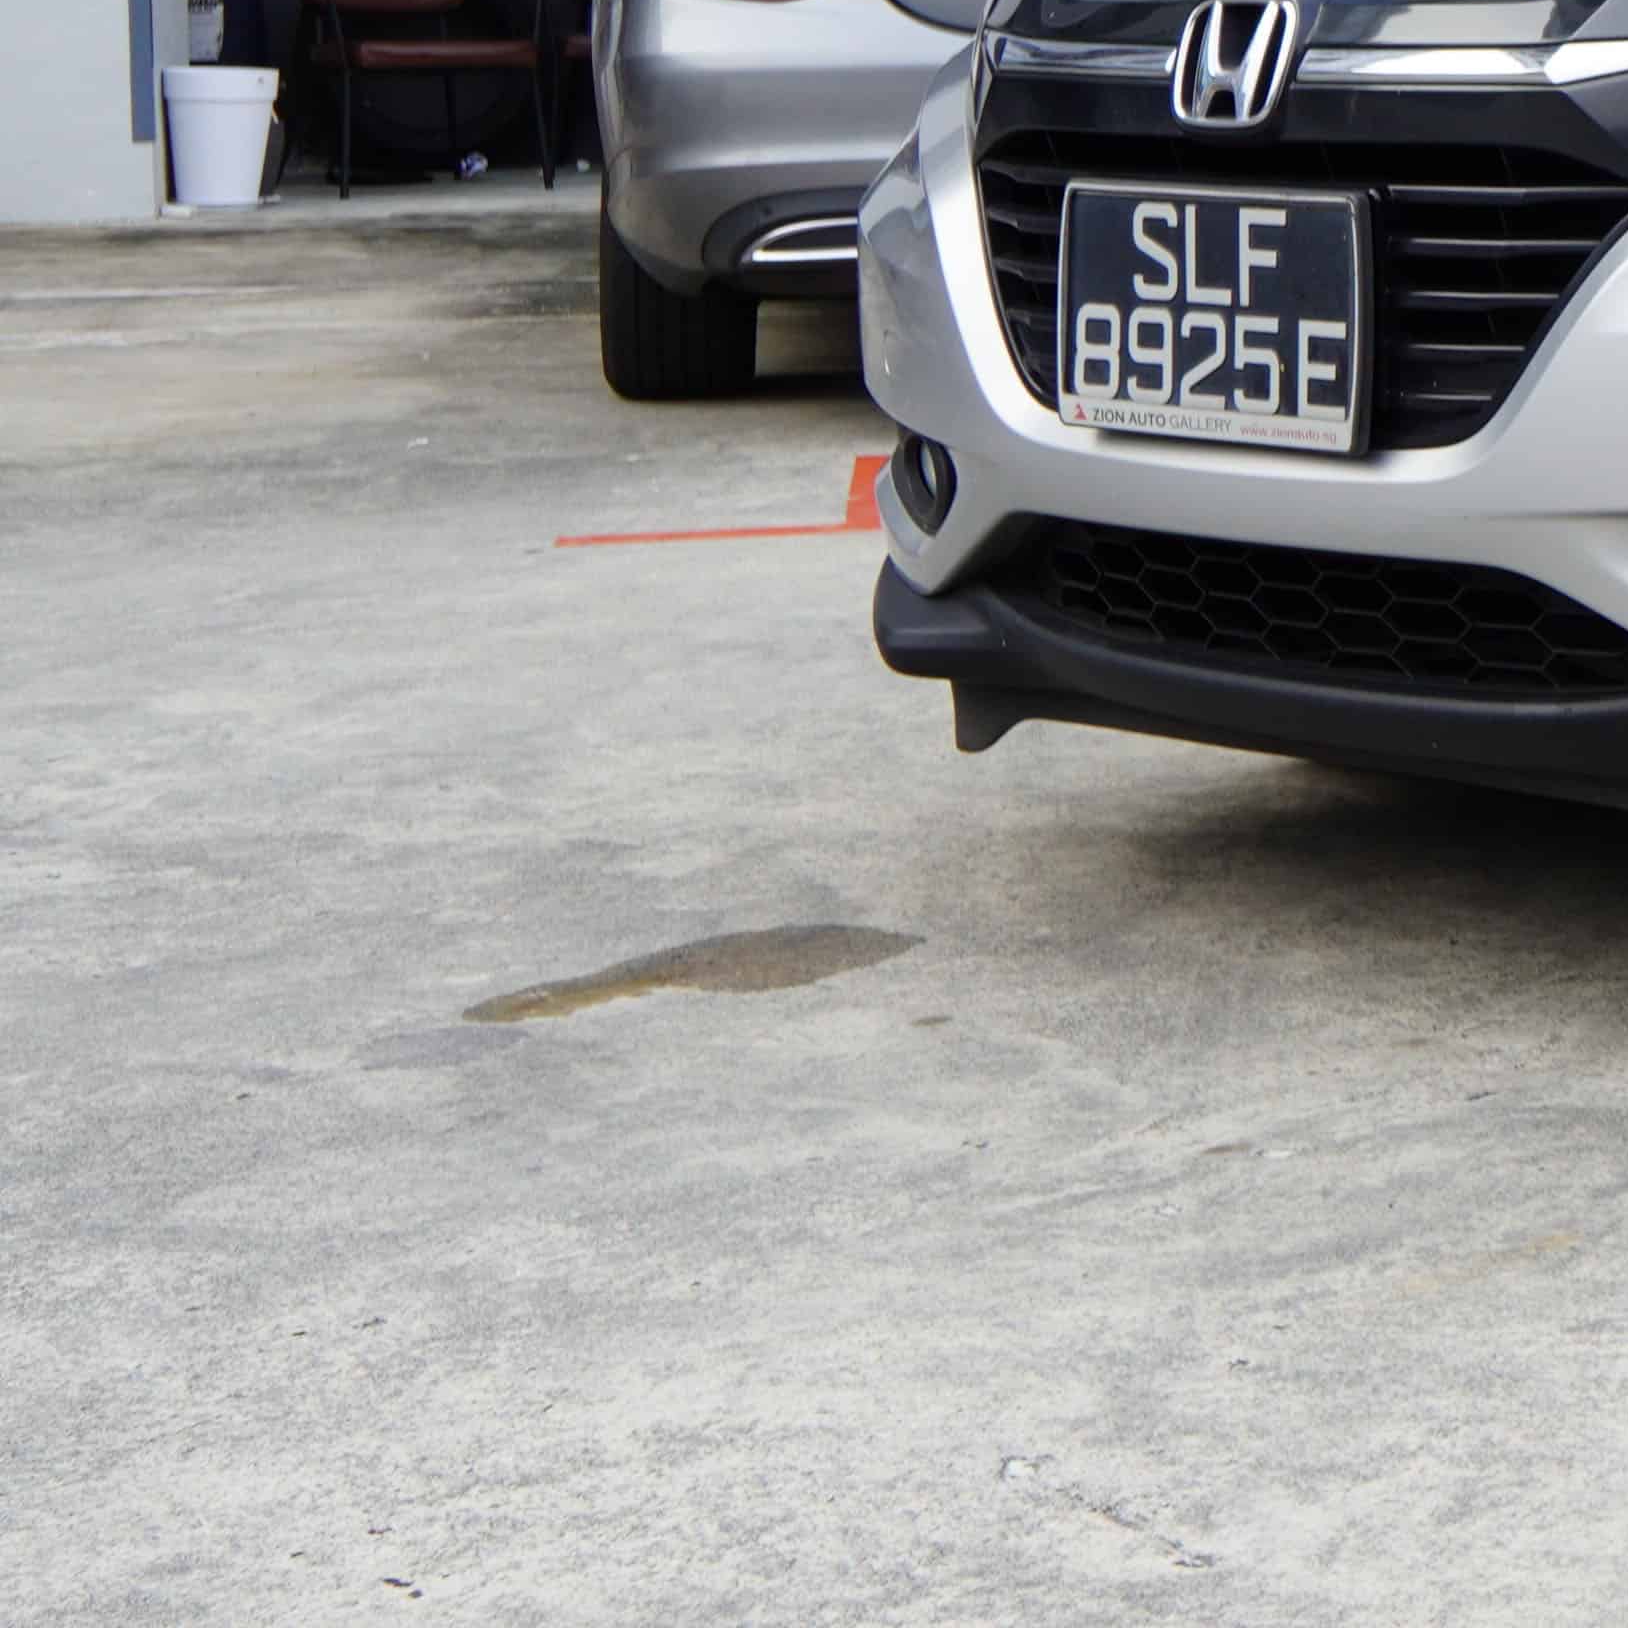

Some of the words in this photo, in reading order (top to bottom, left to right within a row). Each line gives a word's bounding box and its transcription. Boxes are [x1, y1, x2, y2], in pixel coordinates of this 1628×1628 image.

[1132, 201, 1288, 308] SLF
[1074, 302, 1347, 421] 8925E
[1094, 407, 1126, 424] ZION
[1129, 410, 1167, 428] AUTO
[1169, 413, 1232, 434] GALLERY
